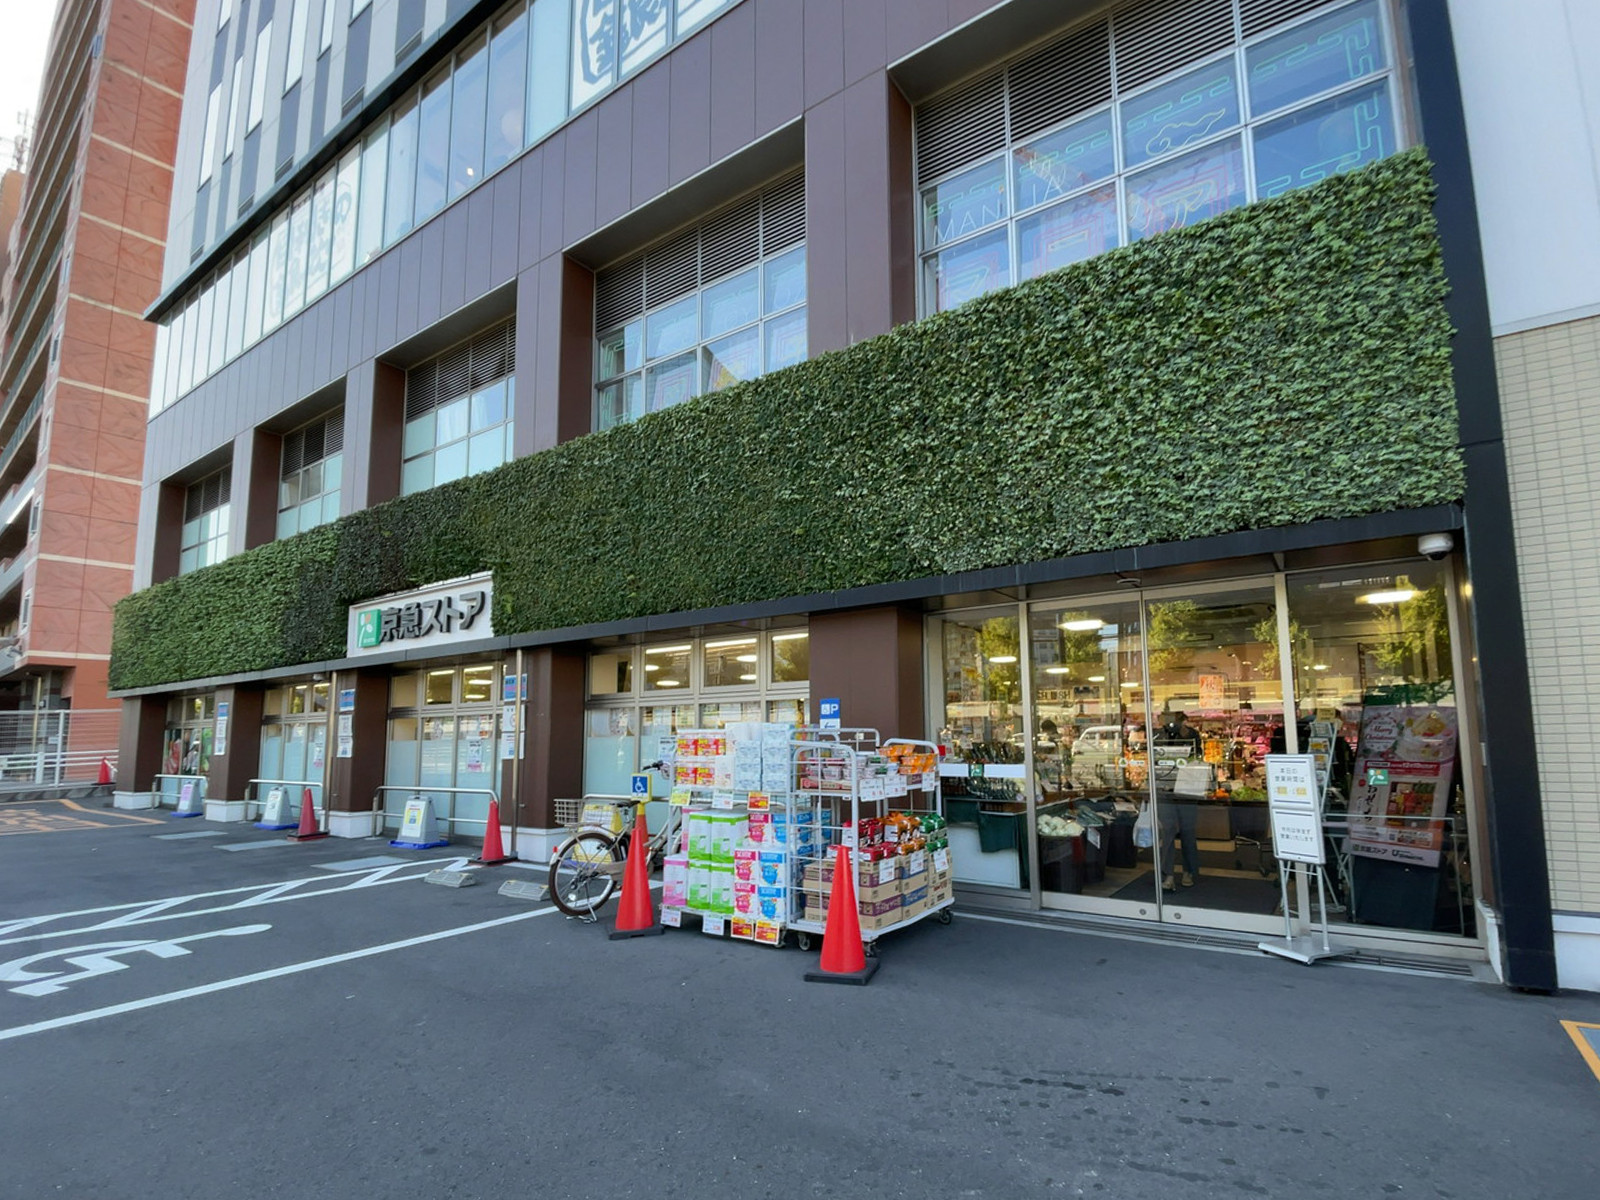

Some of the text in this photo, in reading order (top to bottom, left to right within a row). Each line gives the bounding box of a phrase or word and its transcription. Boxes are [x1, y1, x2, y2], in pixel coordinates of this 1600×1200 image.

[381, 591, 486, 642] 京急ストア
[830, 703, 839, 715] P
